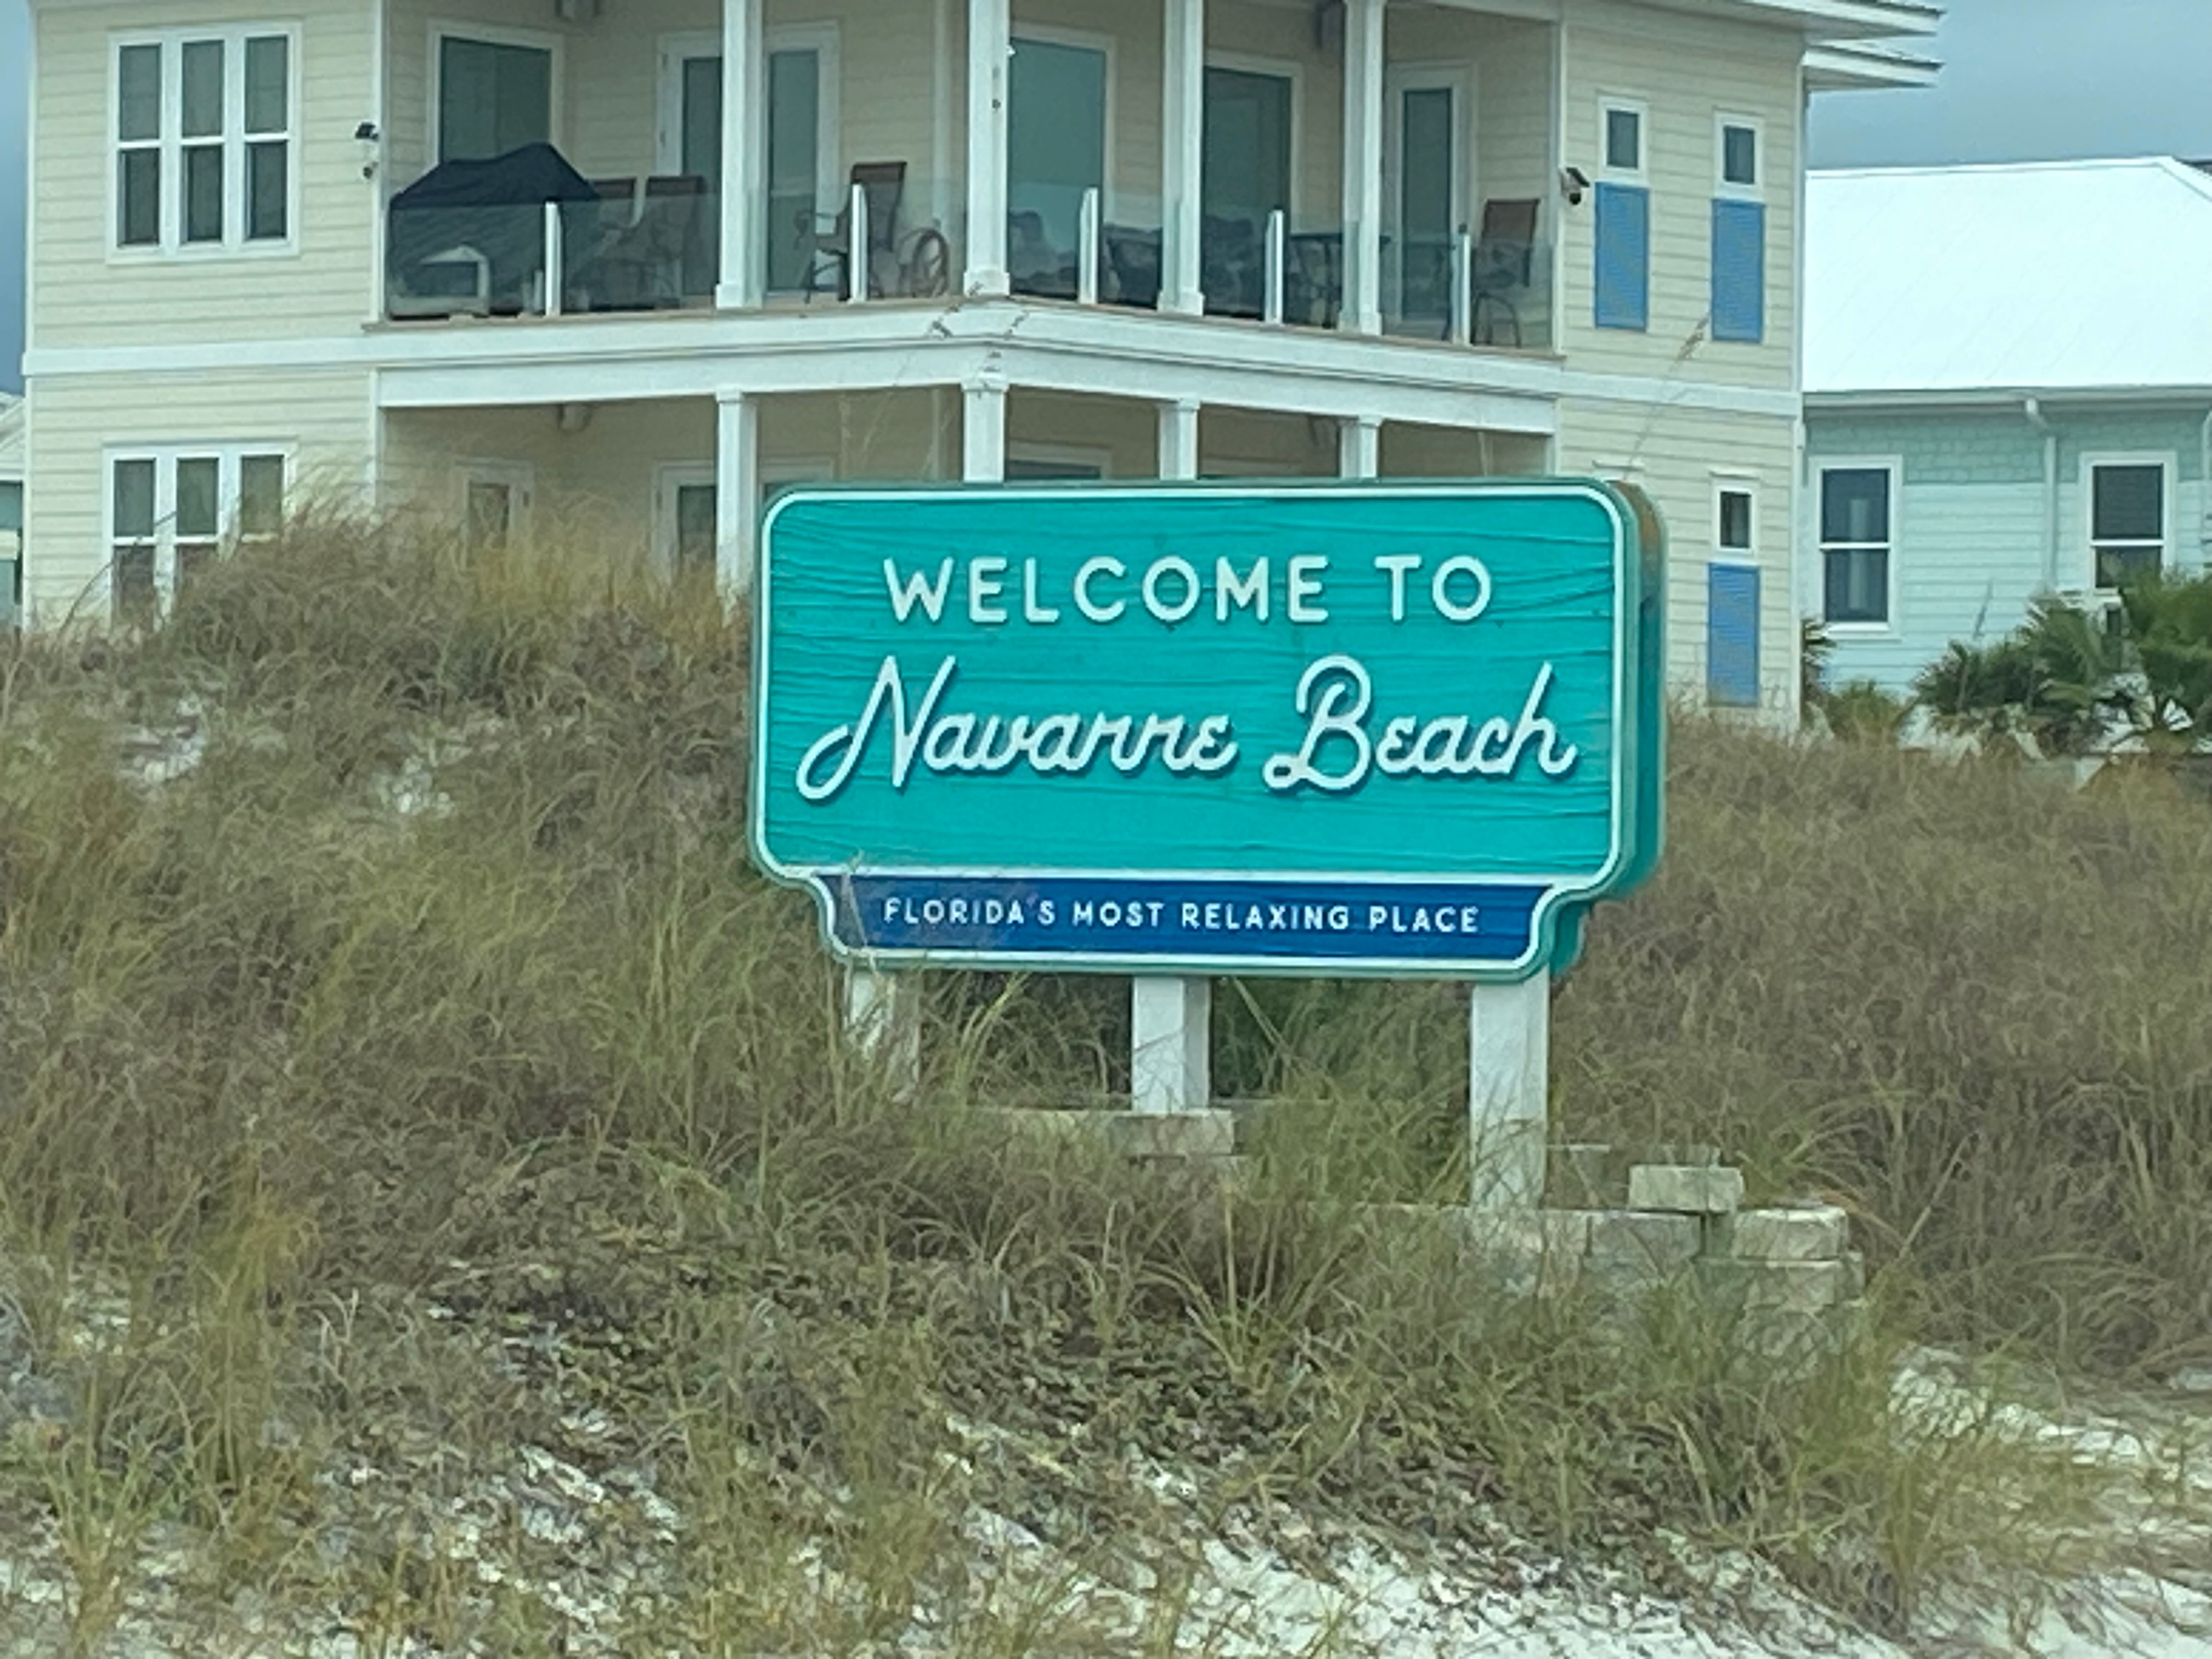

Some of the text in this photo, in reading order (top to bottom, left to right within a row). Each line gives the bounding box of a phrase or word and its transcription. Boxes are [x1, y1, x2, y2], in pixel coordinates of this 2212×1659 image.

[884, 554, 1493, 624] WELCOME TO
[795, 654, 1578, 800] Navarre Beach
[1072, 901, 1164, 928] MOST
[1181, 903, 1350, 931] RELAXING
[1369, 906, 1479, 933] PLACE
